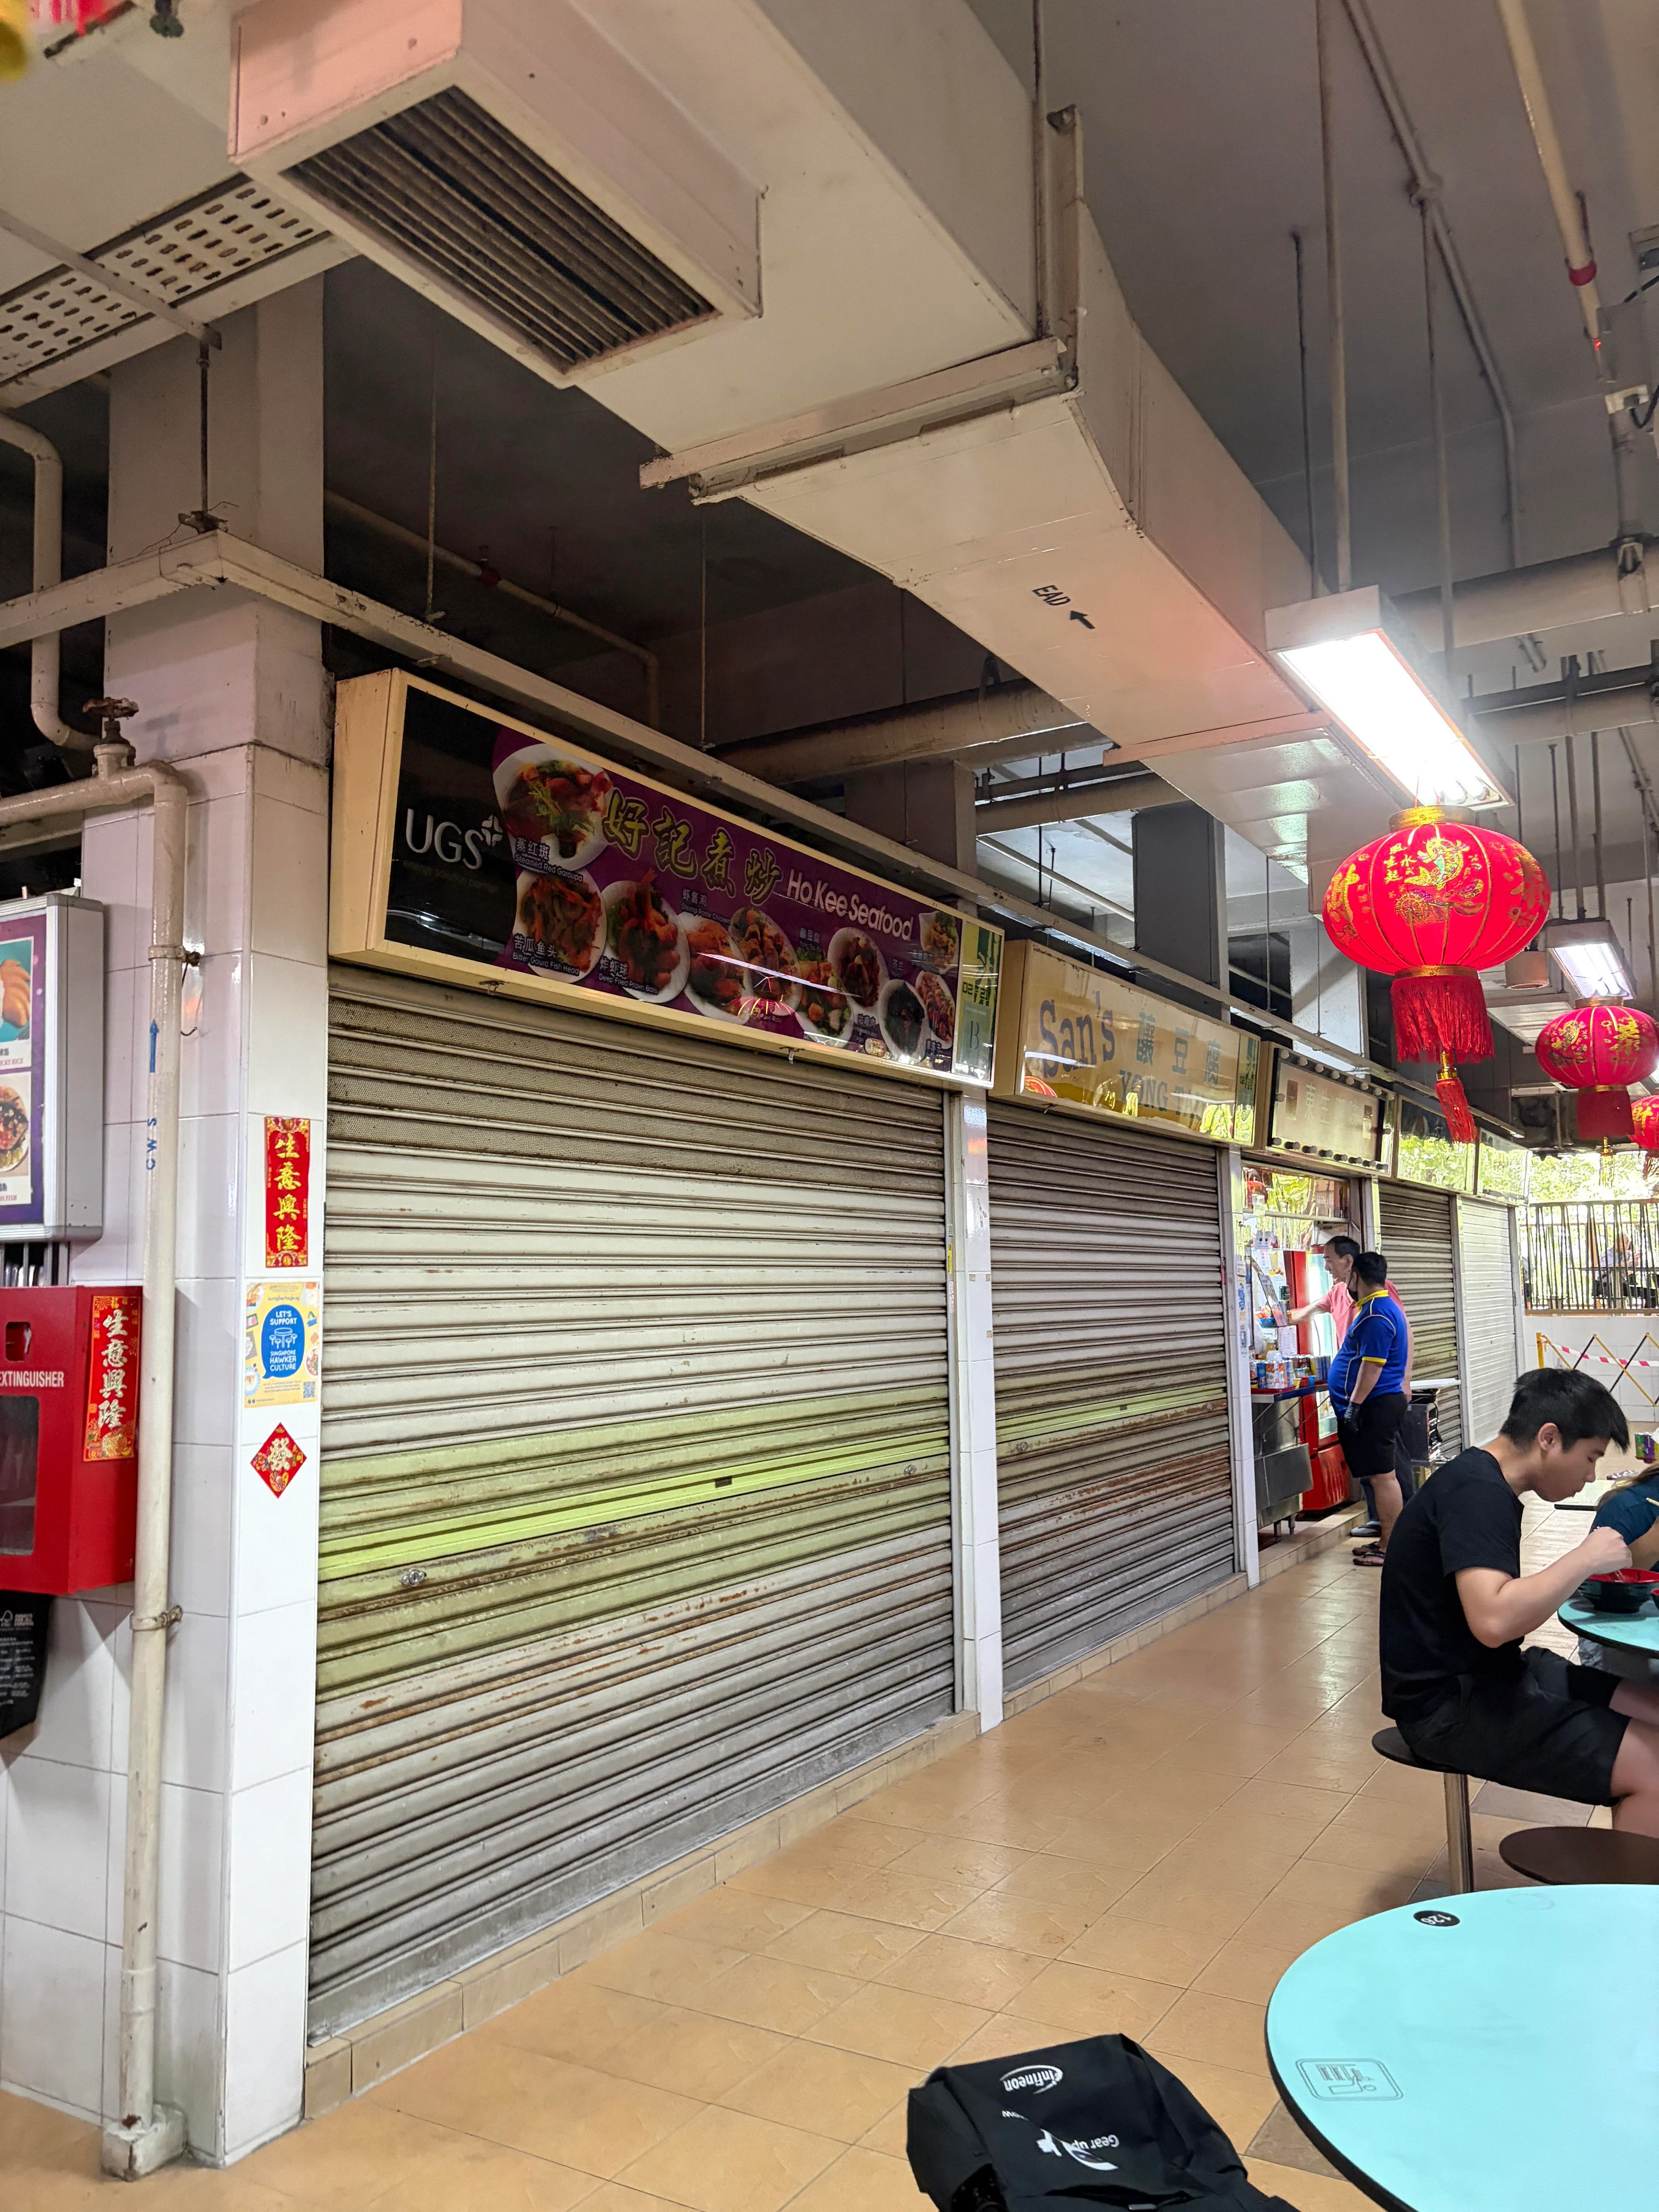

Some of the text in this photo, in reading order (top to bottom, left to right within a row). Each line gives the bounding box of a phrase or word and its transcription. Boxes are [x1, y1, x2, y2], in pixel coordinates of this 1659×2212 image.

[1032, 585, 1071, 606] EAD
[406, 808, 483, 870] UGS
[515, 854, 582, 882] Steamed Red Garoupa
[787, 869, 914, 941] Ho Kee Seafood
[514, 935, 557, 958] 苦瓜鱼头
[531, 957, 549, 967] Gourd
[550, 961, 562, 970] Fish
[563, 965, 579, 975] Head
[599, 973, 614, 983] Deep
[615, 977, 628, 987] Fried
[969, 1020, 979, 1049] B
[1040, 991, 1115, 1078] San's
[1119, 1070, 1169, 1112] YONG
[270, 1317, 297, 1326] SUPPORT
[98, 1309, 129, 1429] 生意興隆
[270, 1355, 296, 1364] HAWKER
[270, 1363, 296, 1372] CULTURE
[1420, 1914, 1451, 1925] 128
[1003, 2070, 1056, 2092] infineon
[1070, 2134, 1120, 2150] Gear up
